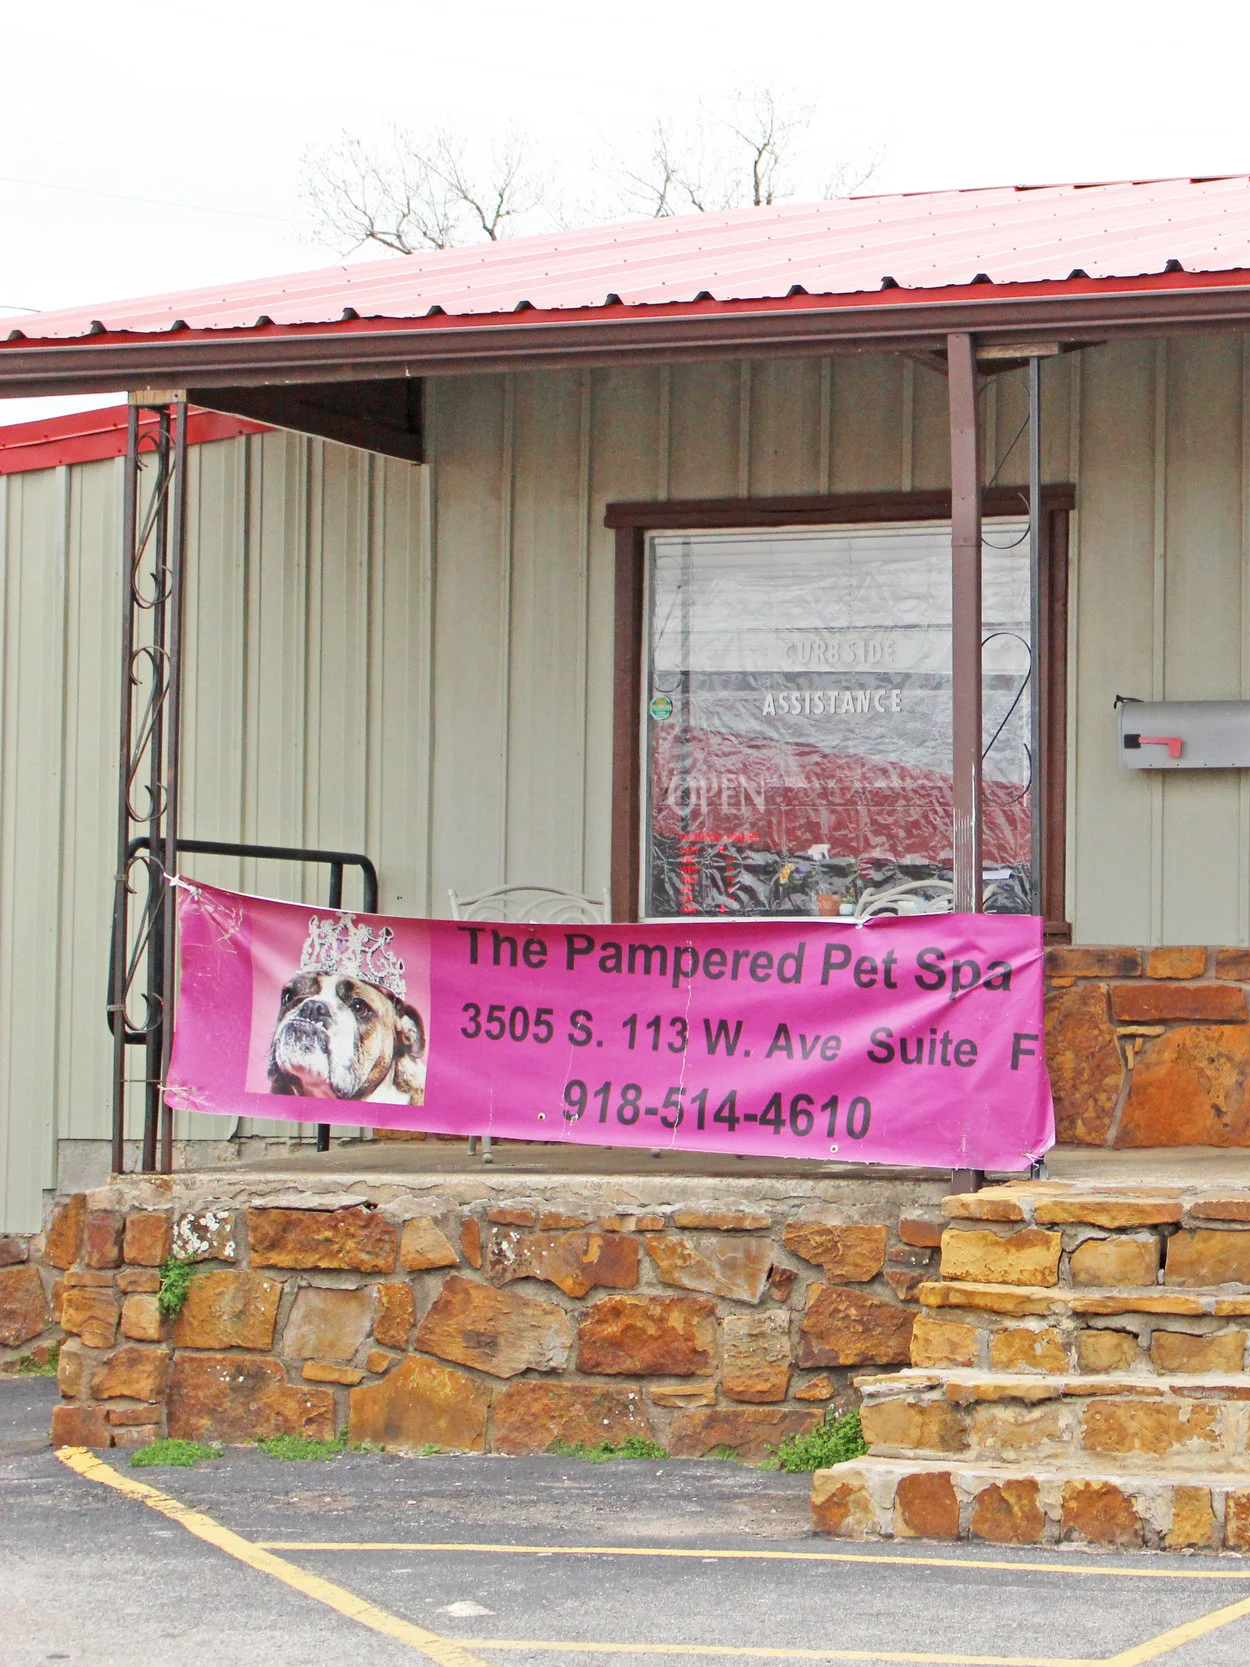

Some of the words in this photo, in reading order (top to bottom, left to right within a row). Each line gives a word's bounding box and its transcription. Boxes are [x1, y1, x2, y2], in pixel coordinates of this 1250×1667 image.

[762, 688, 902, 716] ASSISTANCE
[668, 773, 766, 818] OPEN
[457, 925, 548, 969] The
[564, 932, 806, 989] Pampered
[821, 942, 899, 990] Pet
[914, 947, 1013, 1000] Spa
[460, 1002, 555, 1044] 3505
[568, 1011, 604, 1048] S.
[622, 1013, 688, 1054] 113
[703, 1018, 751, 1058] W.
[766, 1023, 842, 1062] Ave
[867, 1027, 979, 1068] Suite
[1011, 1033, 1039, 1072] F
[563, 1079, 872, 1140] 918-514-4610
